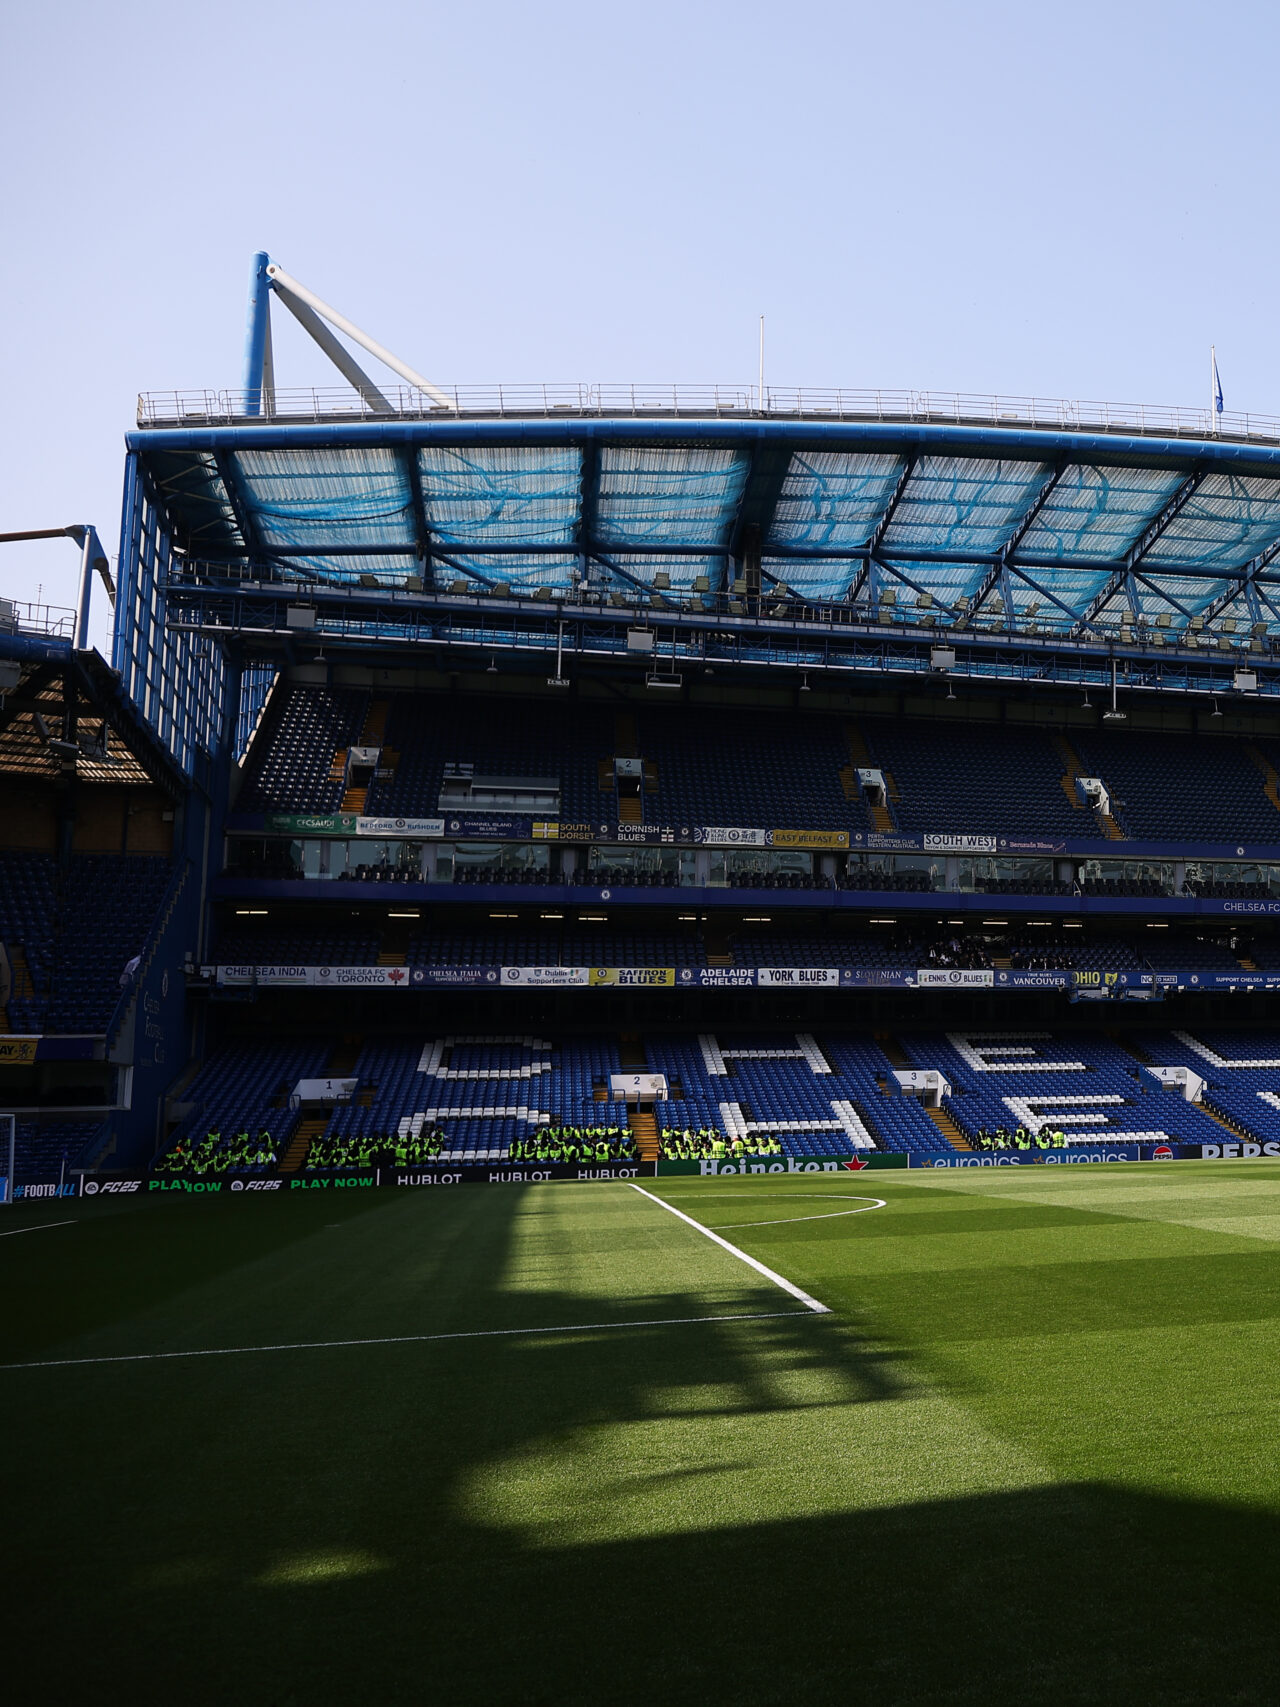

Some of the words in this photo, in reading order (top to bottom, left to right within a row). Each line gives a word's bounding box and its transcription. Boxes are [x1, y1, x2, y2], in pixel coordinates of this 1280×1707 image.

[364, 749, 368, 757] 1
[618, 825, 660, 833] CORNISH
[560, 832, 596, 840] DORSET
[776, 834, 796, 842] EAST
[799, 835, 833, 843] BELFAST
[926, 835, 963, 846] SOUTH
[967, 836, 995, 847] WEST
[1224, 903, 1266, 912] CHELSEA
[1268, 904, 1280, 912] FC
[226, 968, 276, 976] CHELSEA
[279, 968, 307, 976] INDIA
[700, 969, 755, 977] ADELAIDE
[769, 970, 794, 982] YORK
[799, 970, 828, 982] BLUES
[856, 970, 902, 978] SLOVENIAN
[336, 975, 385, 983] TORONTO
[620, 976, 667, 984] BLUES
[702, 978, 753, 986] CHELSEA
[964, 975, 983, 983] BLUES
[1013, 978, 1066, 986] VANCOUVER
[912, 1072, 917, 1080] 3
[634, 1077, 640, 1085] 2
[326, 1081, 332, 1090] 1
[934, 1153, 1020, 1168] euronics
[1045, 1150, 1128, 1165] euronics
[698, 1158, 838, 1176] Heineken
[489, 1171, 552, 1183] HUBLOT
[578, 1168, 639, 1180] HUBLOT
[291, 1179, 330, 1189] PLAY
[334, 1177, 374, 1188] NOW
[397, 1173, 462, 1186] HUBLOT
[12, 1184, 75, 1198] #FOOTBALL
